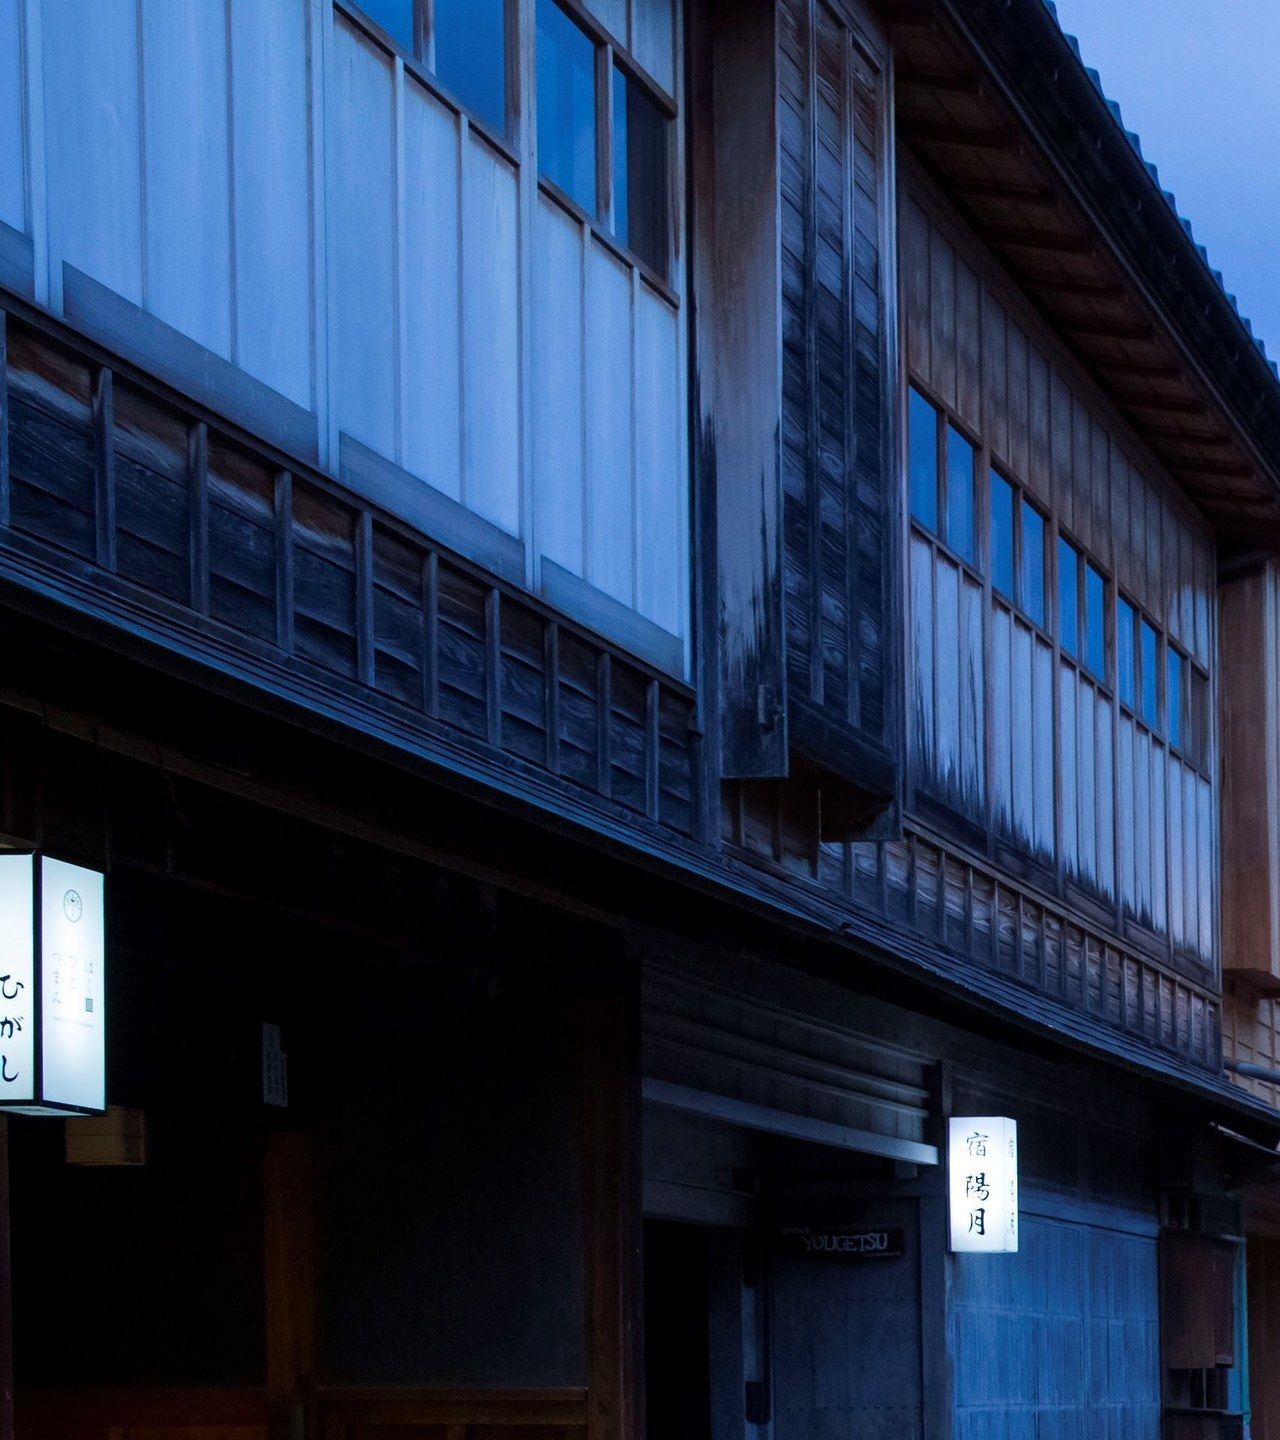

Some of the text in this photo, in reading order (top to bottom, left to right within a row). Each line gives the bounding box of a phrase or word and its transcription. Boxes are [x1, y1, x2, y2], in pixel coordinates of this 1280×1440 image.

[0, 974, 24, 1082] ひがし
[965, 1131, 991, 1236] 宿陽月
[799, 1232, 888, 1252] YOUGETSU
